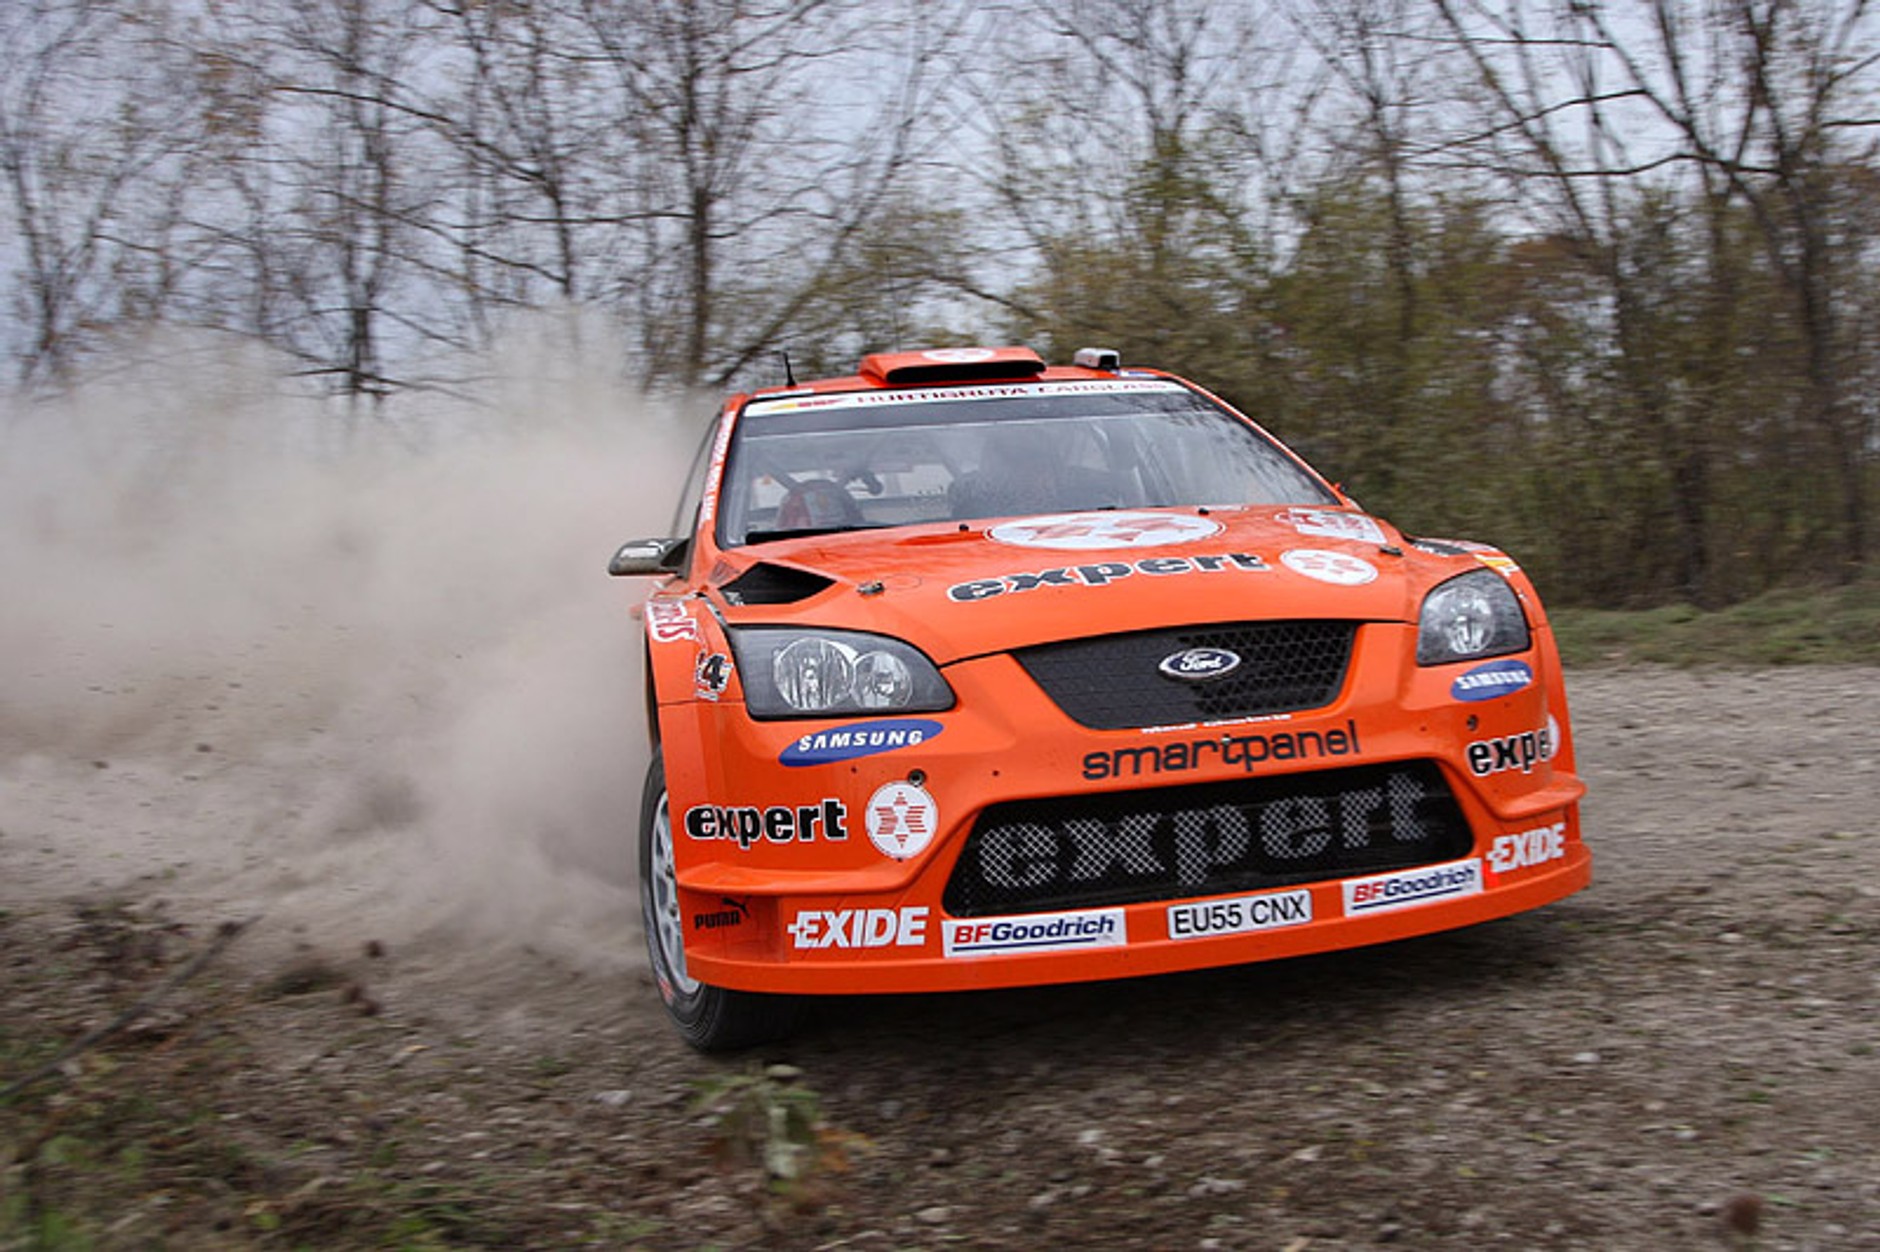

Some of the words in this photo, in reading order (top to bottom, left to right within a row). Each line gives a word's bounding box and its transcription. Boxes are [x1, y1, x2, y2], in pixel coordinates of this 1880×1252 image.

[948, 552, 1270, 601] expert
[1456, 669, 1531, 689] SAMSUNG
[798, 730, 923, 752] SAMSUNG
[1082, 719, 1360, 780] smartpanel
[685, 798, 848, 850] expert
[977, 772, 1428, 888] expert
[1486, 823, 1566, 874] EXIDE
[1353, 866, 1475, 902] BFGoodrich
[787, 906, 930, 948] EXIDE
[953, 906, 1115, 944] BFGoodrich
[1174, 904, 1243, 934] EU55
[1250, 895, 1306, 924] CNX
